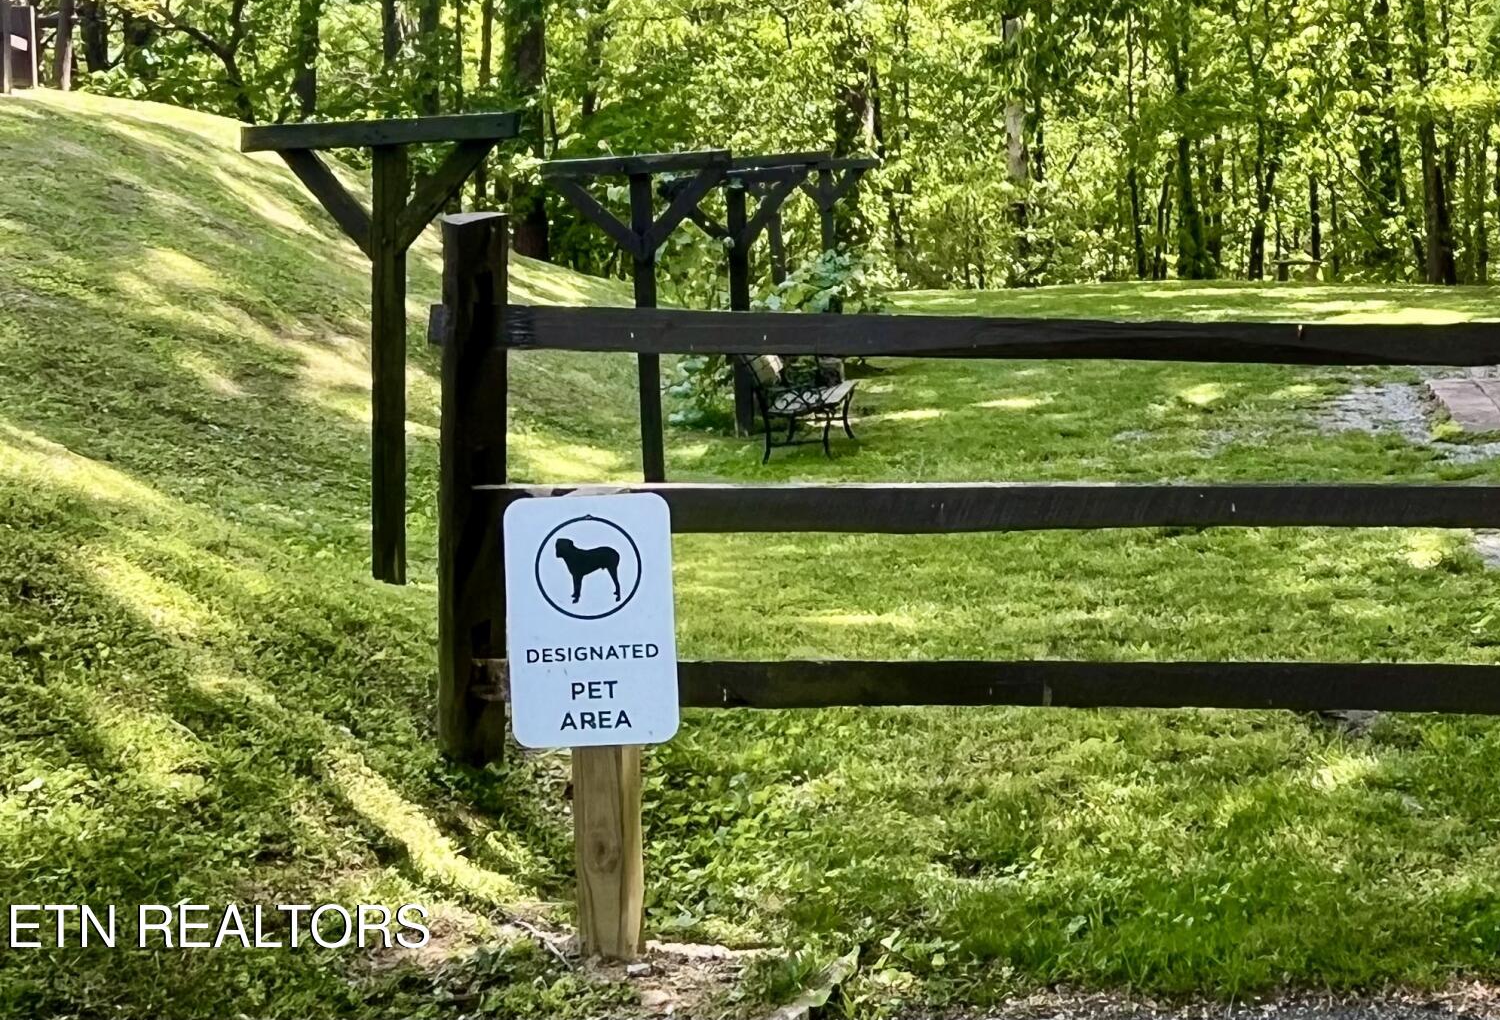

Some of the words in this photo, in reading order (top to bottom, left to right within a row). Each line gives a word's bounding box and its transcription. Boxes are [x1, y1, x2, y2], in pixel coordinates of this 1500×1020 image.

[526, 643, 659, 664] DESIGNATED
[571, 680, 618, 700] PET
[560, 709, 632, 731] AREA
